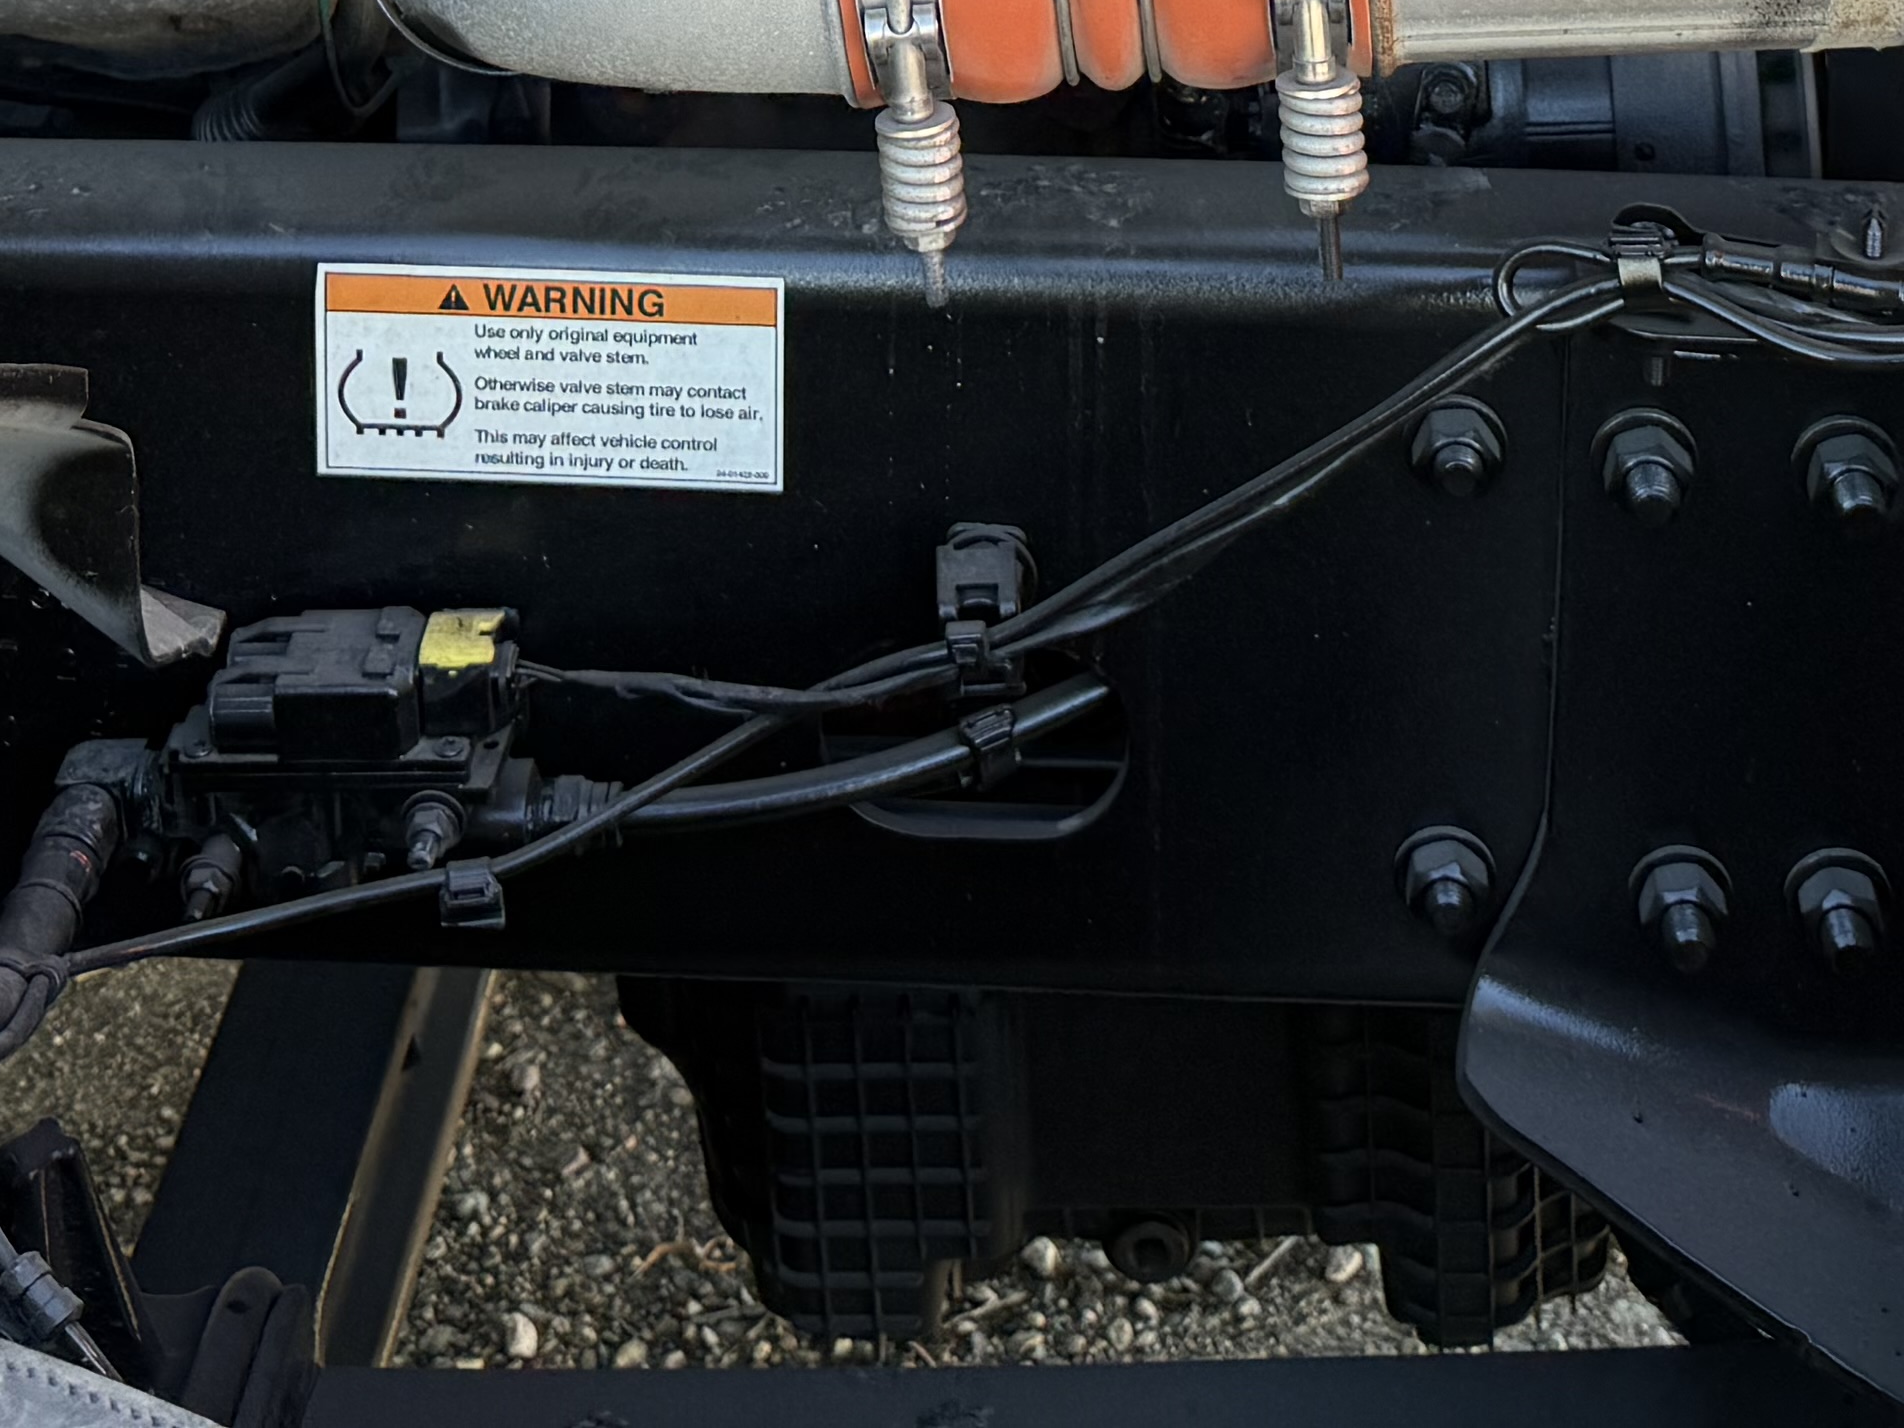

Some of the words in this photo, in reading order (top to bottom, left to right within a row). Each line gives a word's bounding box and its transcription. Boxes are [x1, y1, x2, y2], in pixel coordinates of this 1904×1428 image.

[482, 283, 665, 317] WARNING
[474, 324, 505, 339] Use
[510, 325, 544, 344] only
[548, 326, 608, 344] original
[613, 330, 698, 347] equipment
[474, 346, 520, 360] wheel
[525, 348, 555, 362] and
[560, 350, 602, 363] valve
[606, 351, 649, 365] stem.
[474, 376, 555, 393] Otherwise
[560, 379, 602, 395] valve
[606, 381, 645, 396] stem
[649, 384, 683, 401] may
[687, 385, 747, 400] contact
[474, 397, 520, 412] brake
[523, 399, 577, 416] caliper
[581, 402, 645, 419] causing
[649, 403, 675, 417] tire
[680, 404, 695, 417] to
[700, 405, 734, 419] lose
[738, 407, 763, 421] air.
[474, 429, 508, 444] This
[512, 433, 546, 448] may
[551, 432, 596, 447] affect
[600, 434, 657, 449] vehicle
[661, 437, 717, 451] control
[475, 451, 545, 468] resulting
[550, 453, 564, 466] in
[569, 454, 613, 471] injury
[618, 457, 635, 470] or
[640, 456, 688, 471] death.
